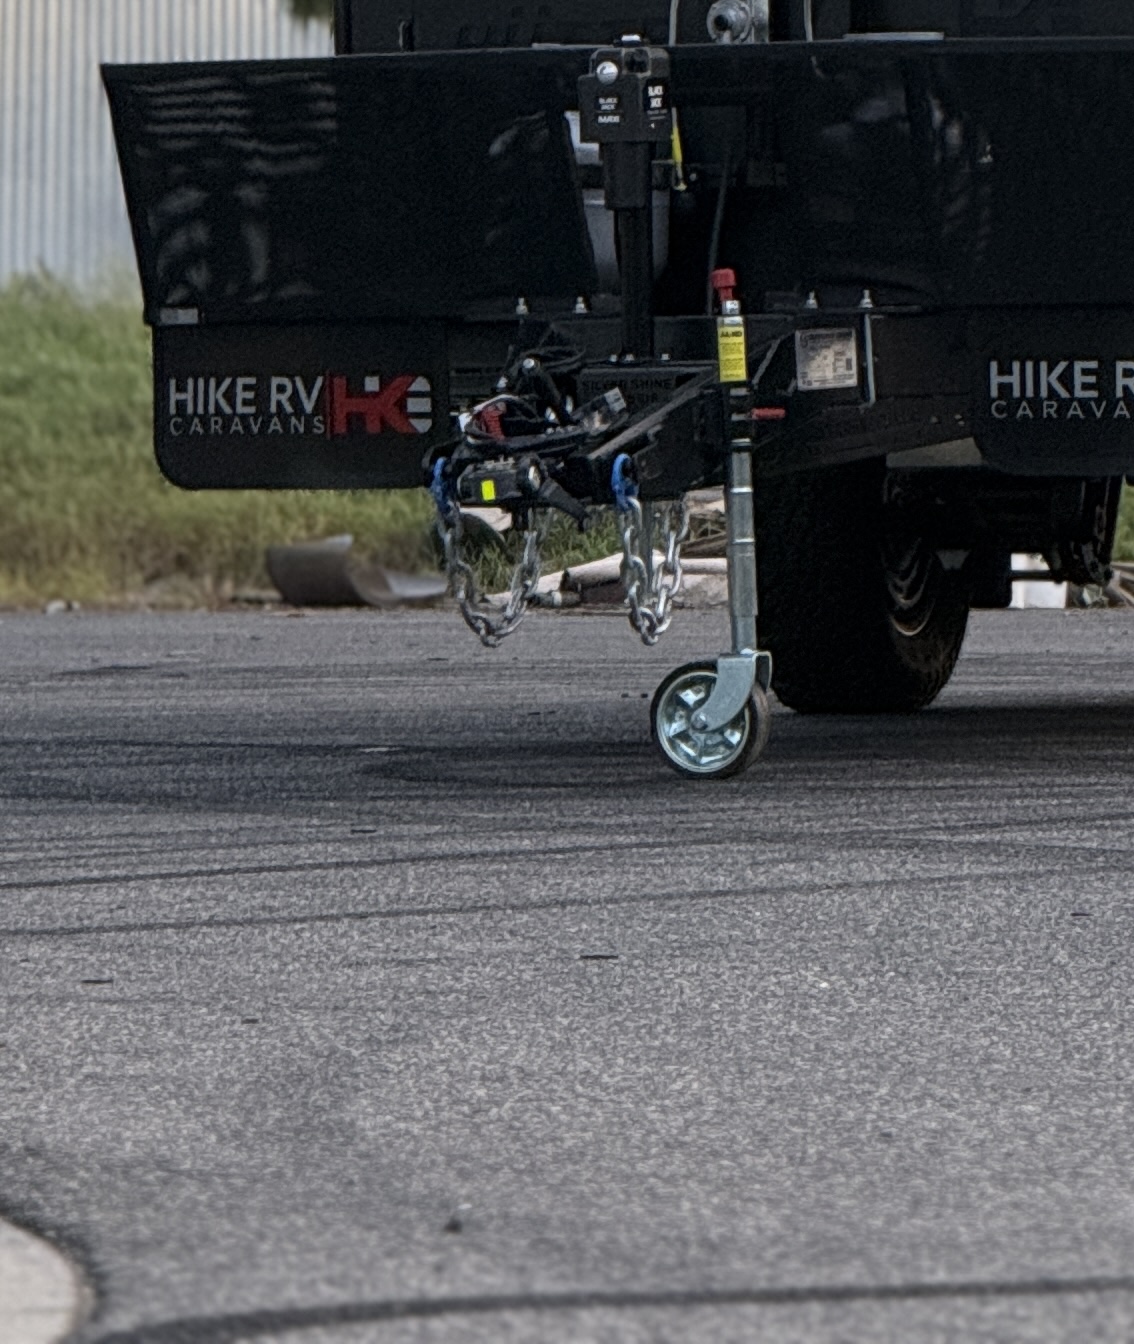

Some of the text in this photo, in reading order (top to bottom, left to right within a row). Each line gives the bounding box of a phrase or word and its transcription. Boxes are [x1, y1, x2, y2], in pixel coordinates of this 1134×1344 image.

[168, 375, 256, 416] HIKE
[269, 374, 324, 415] RV
[989, 360, 1099, 399] HIKE
[168, 415, 326, 436] CARAVANS
